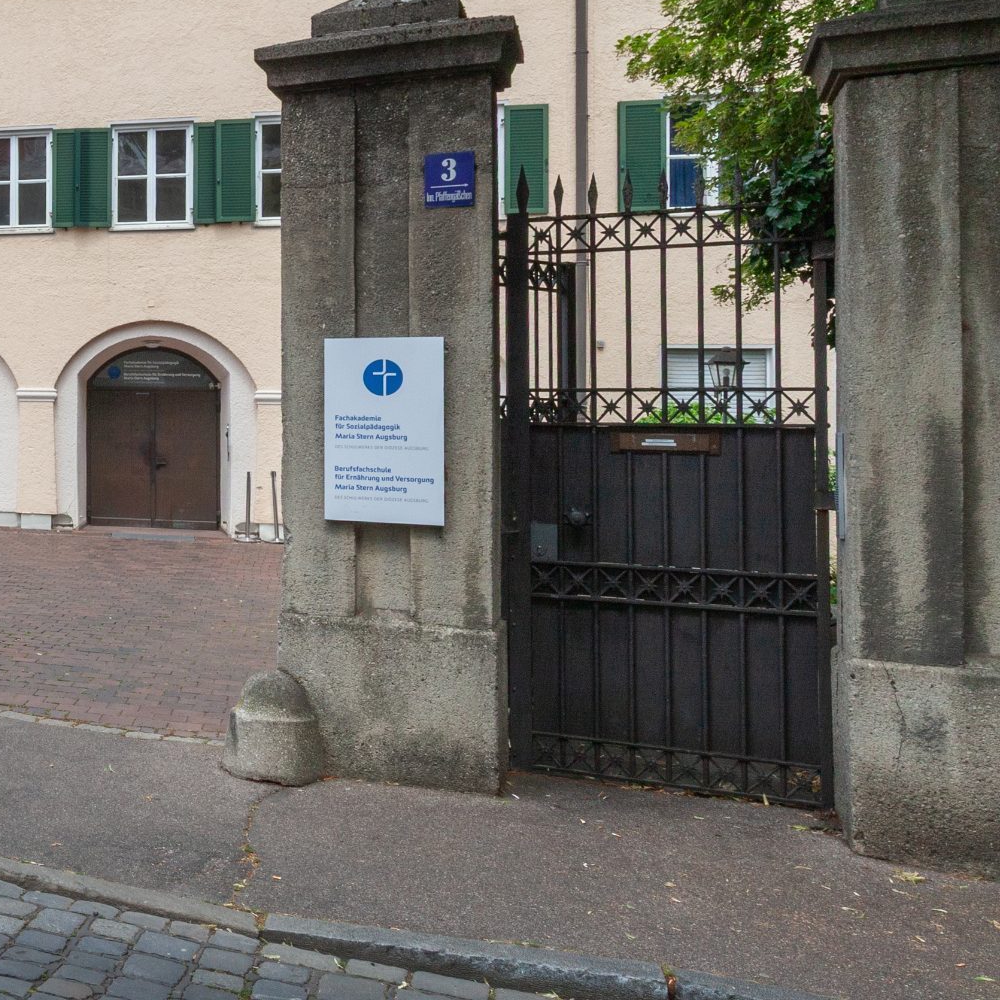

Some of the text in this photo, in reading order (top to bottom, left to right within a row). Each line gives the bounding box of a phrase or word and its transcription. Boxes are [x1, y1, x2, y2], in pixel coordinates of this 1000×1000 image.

[441, 158, 456, 181] 3
[335, 414, 381, 422] Fachakademie
[346, 423, 400, 431] Sozialpädagogik
[375, 434, 408, 442] Augsburg
[334, 465, 391, 473] Berufsfachschule
[346, 474, 380, 482] Ernährung
[395, 476, 435, 484] Versorgung
[375, 485, 407, 493] Augsburg
